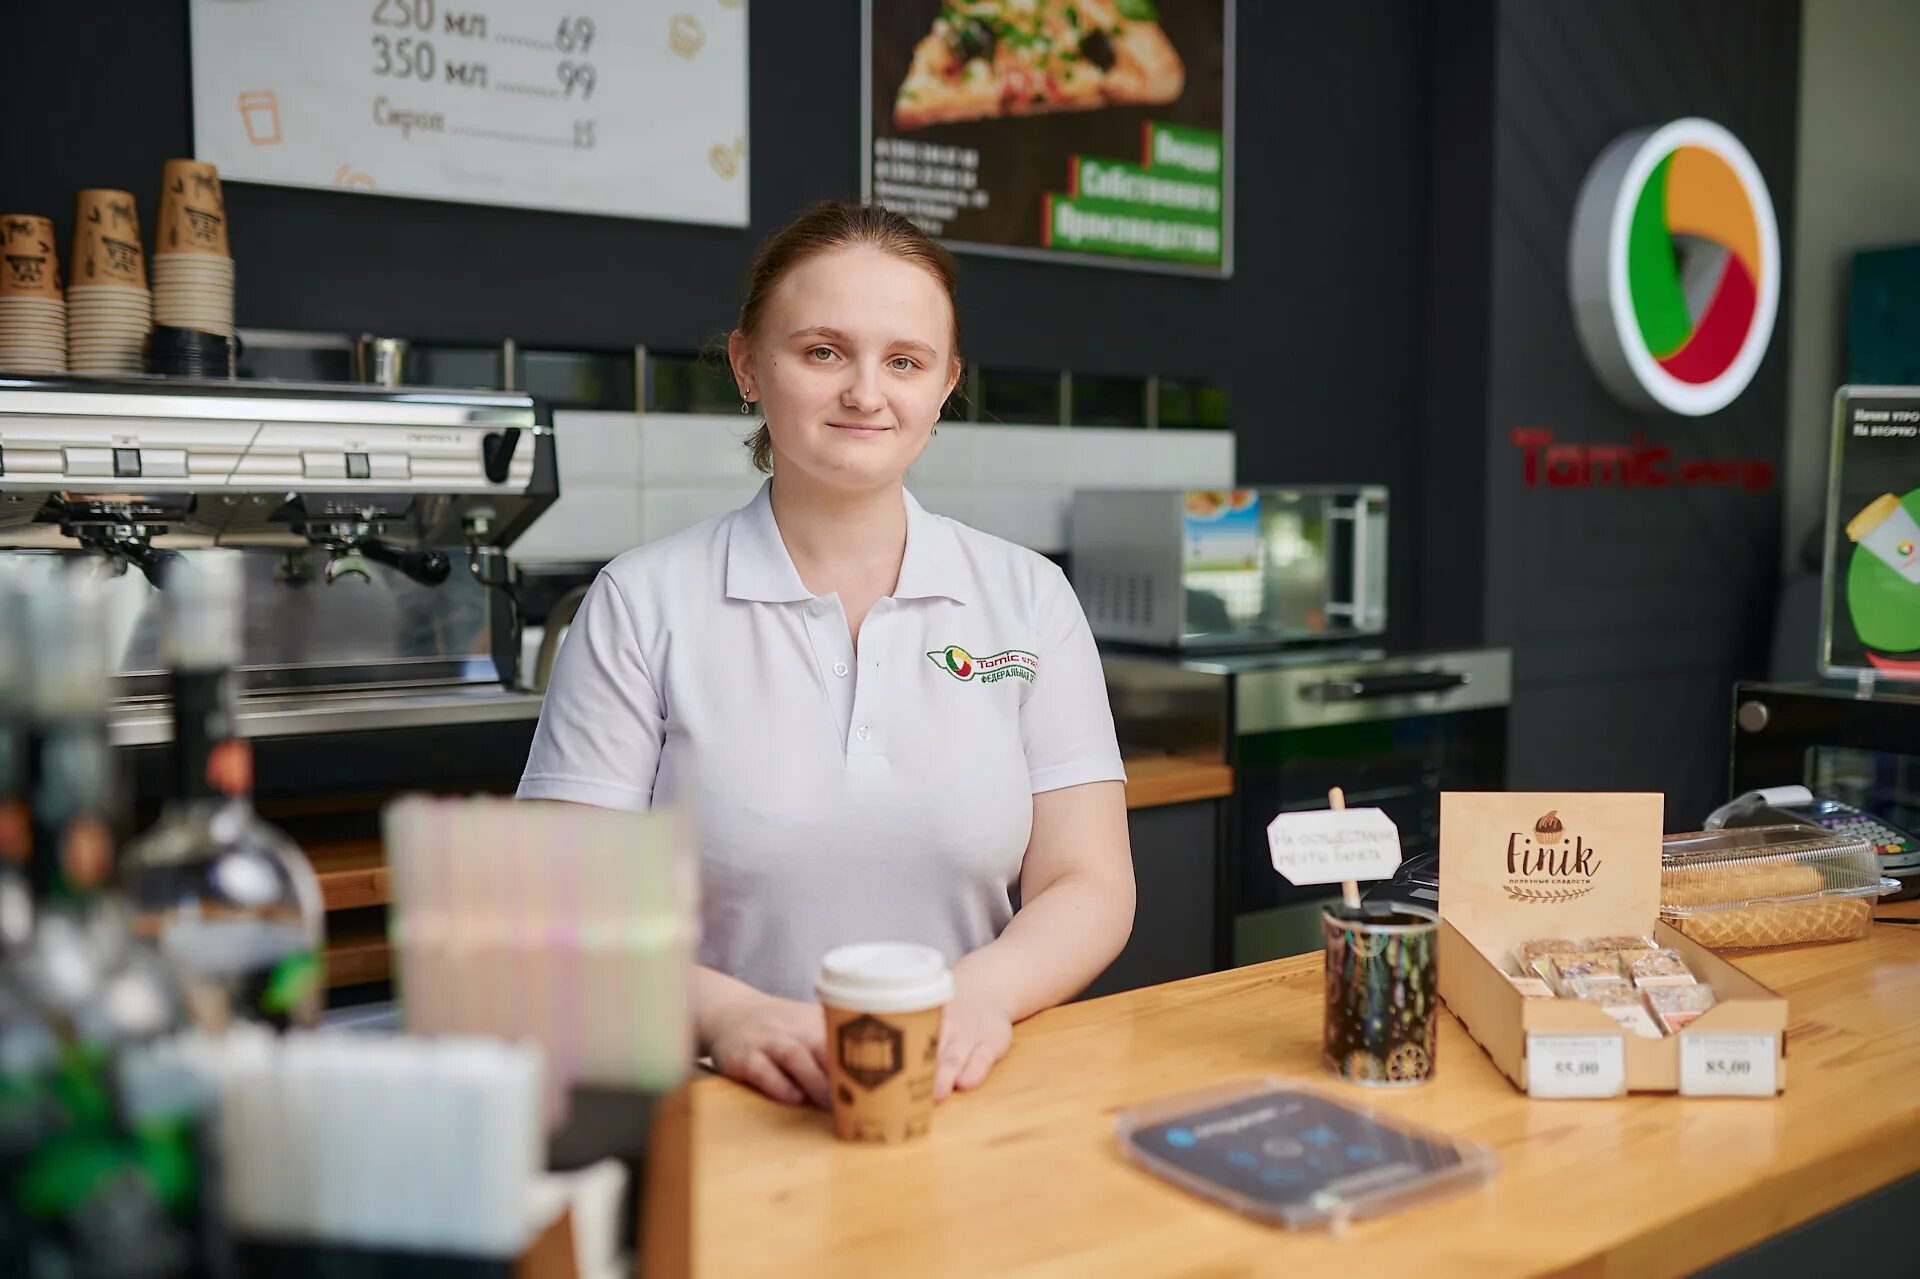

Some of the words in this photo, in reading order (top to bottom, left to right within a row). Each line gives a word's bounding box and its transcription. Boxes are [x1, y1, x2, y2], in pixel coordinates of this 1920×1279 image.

[372, 0, 435, 32] 250
[444, 10, 487, 39] мл
[555, 15, 596, 53] 69
[372, 34, 436, 81] 350
[444, 57, 488, 89] мл
[556, 60, 596, 100] 99
[1507, 832, 1602, 876] Finik
